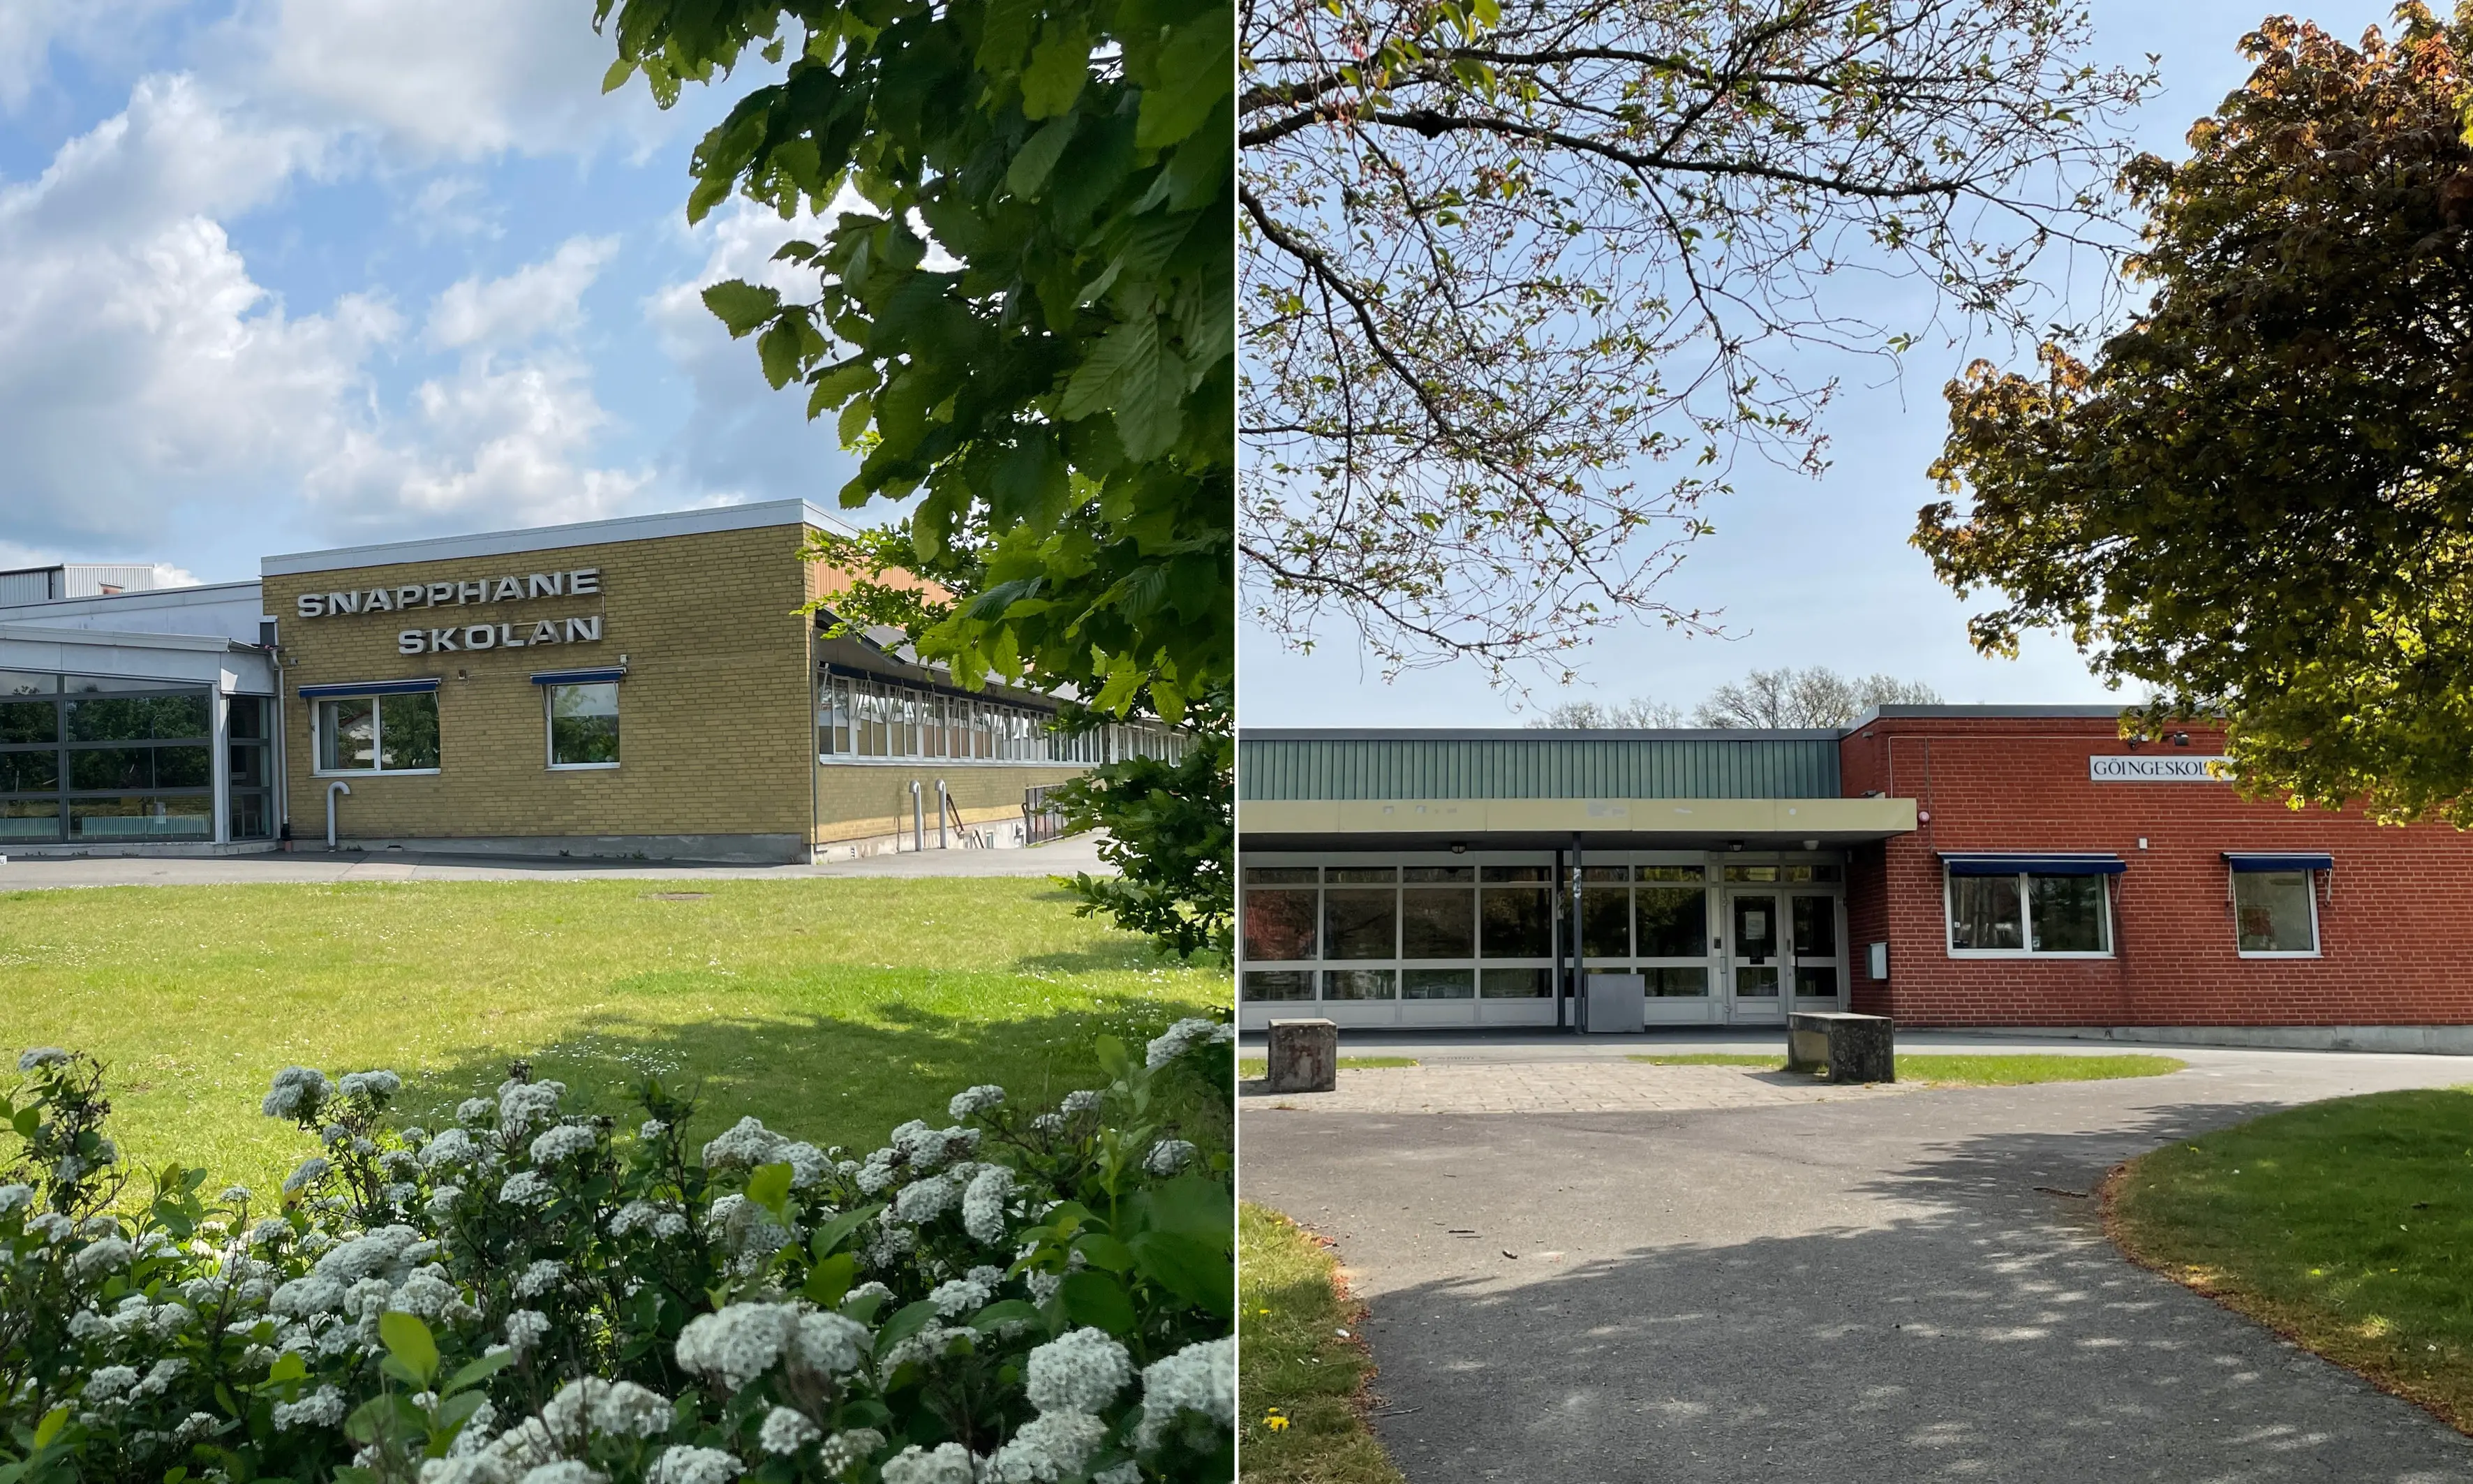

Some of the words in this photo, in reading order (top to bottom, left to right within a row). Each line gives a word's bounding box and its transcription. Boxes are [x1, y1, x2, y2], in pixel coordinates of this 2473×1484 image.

[297, 568, 601, 617] SNAPPHANE
[398, 616, 602, 655] SKOLAN
[2094, 758, 2227, 776] GÖINGESKOL
